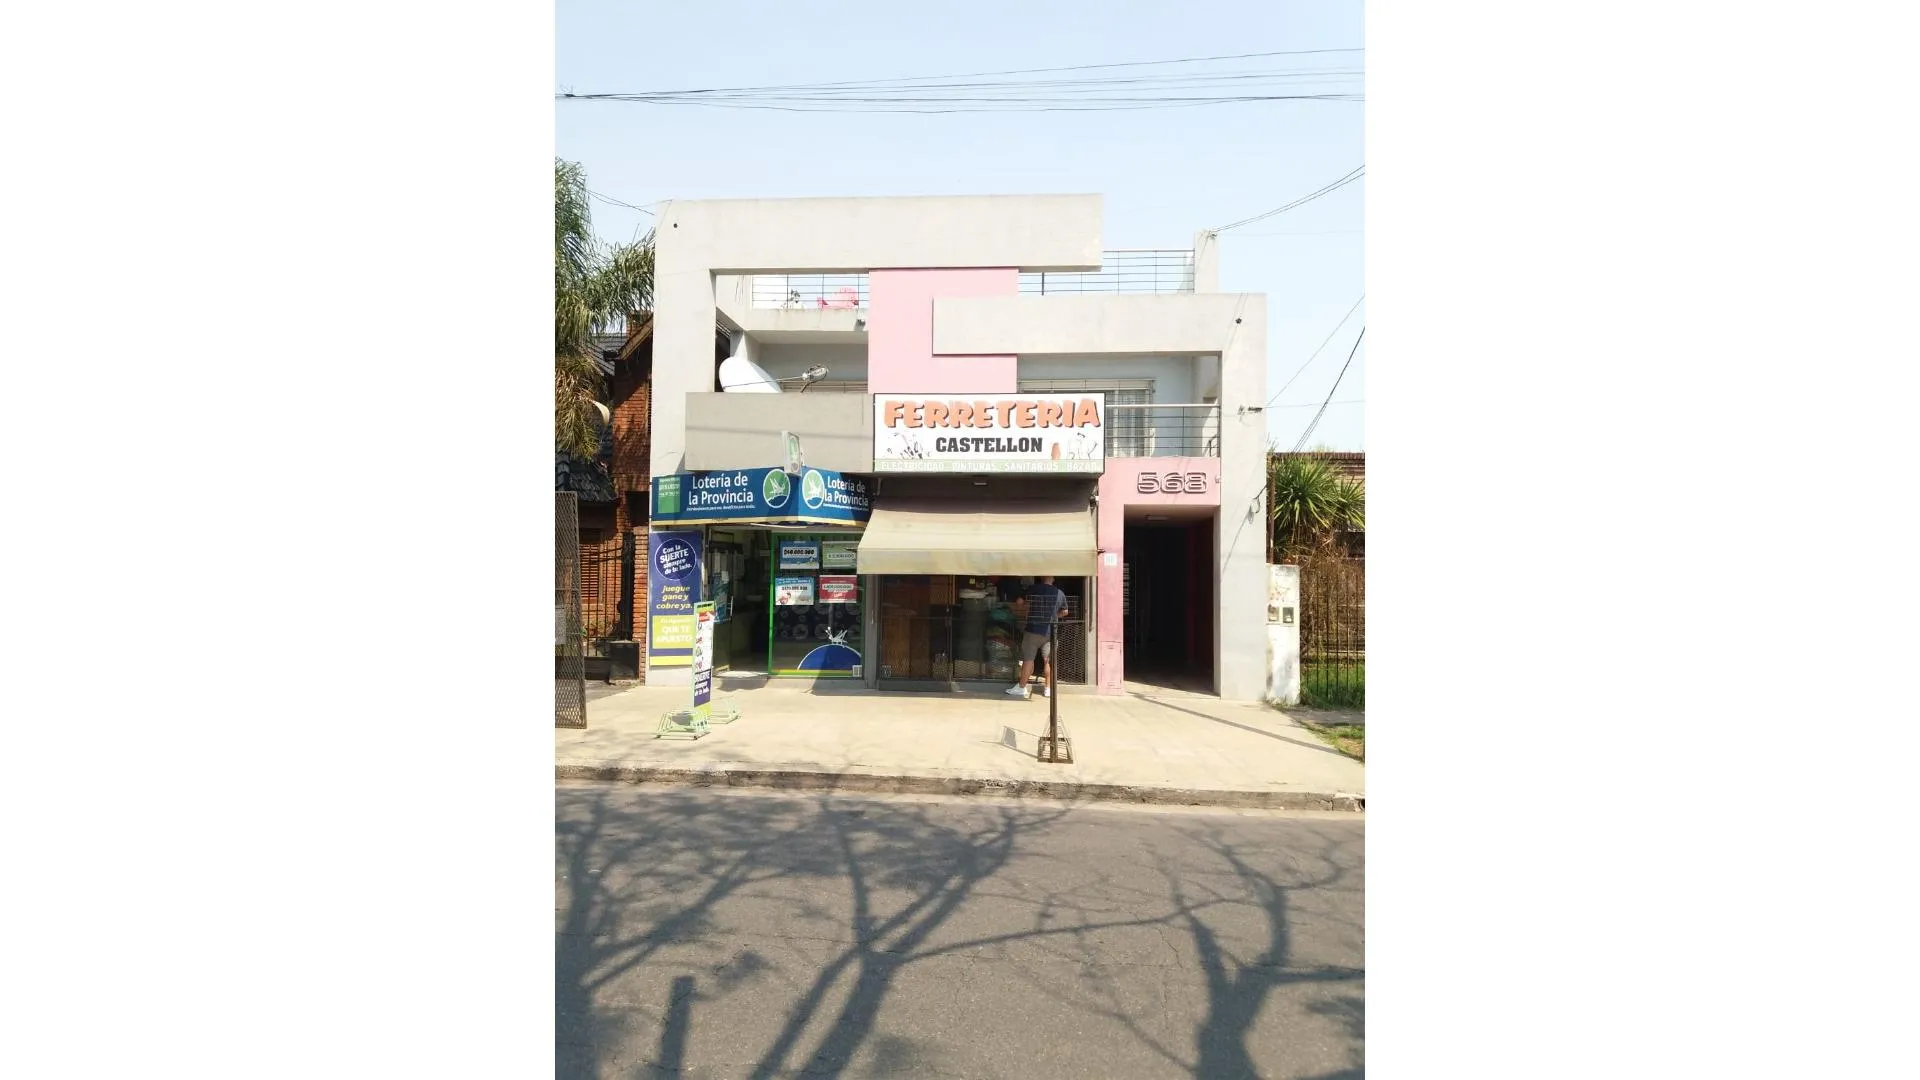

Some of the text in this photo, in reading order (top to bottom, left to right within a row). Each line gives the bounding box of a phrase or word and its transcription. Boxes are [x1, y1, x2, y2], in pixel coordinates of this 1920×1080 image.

[884, 398, 1101, 429] FERRETERIA
[936, 437, 1043, 453] CASTELLON
[692, 473, 731, 490] Lotería
[734, 471, 748, 487] de
[856, 480, 866, 493] de
[1136, 471, 1208, 495] 568
[688, 489, 754, 506] la Provincia
[824, 488, 869, 506] la Provincia
[660, 548, 689, 564] SUERTE
[662, 547, 675, 555] Con
[661, 585, 690, 594] juegue
[682, 594, 689, 602] y
